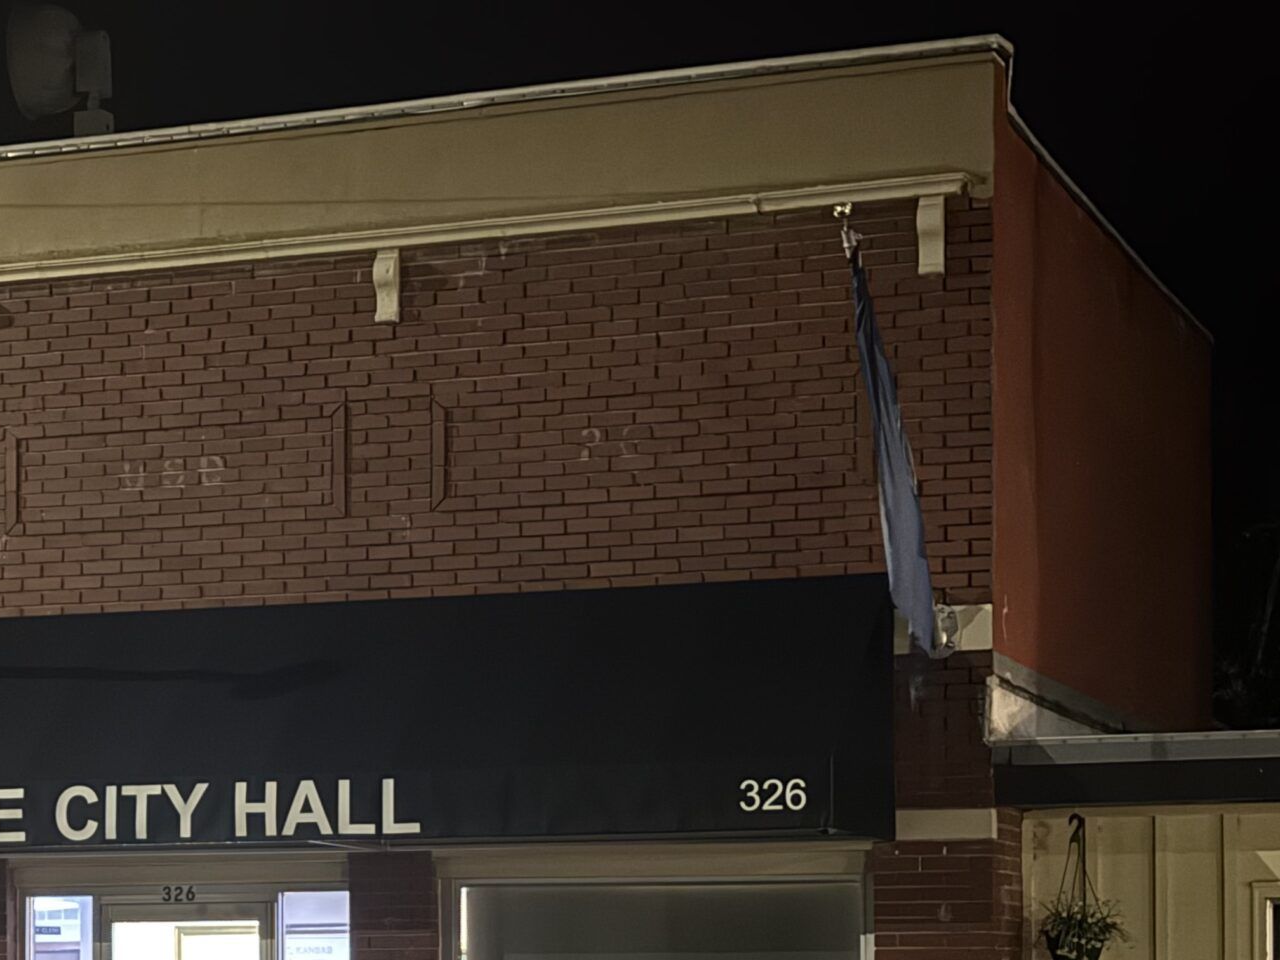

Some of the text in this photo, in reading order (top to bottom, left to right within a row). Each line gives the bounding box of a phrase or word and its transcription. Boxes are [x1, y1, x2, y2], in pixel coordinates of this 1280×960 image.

[55, 781, 209, 841] CITY
[234, 778, 421, 837] HALL
[739, 778, 807, 812] 326
[162, 886, 196, 902] 326
